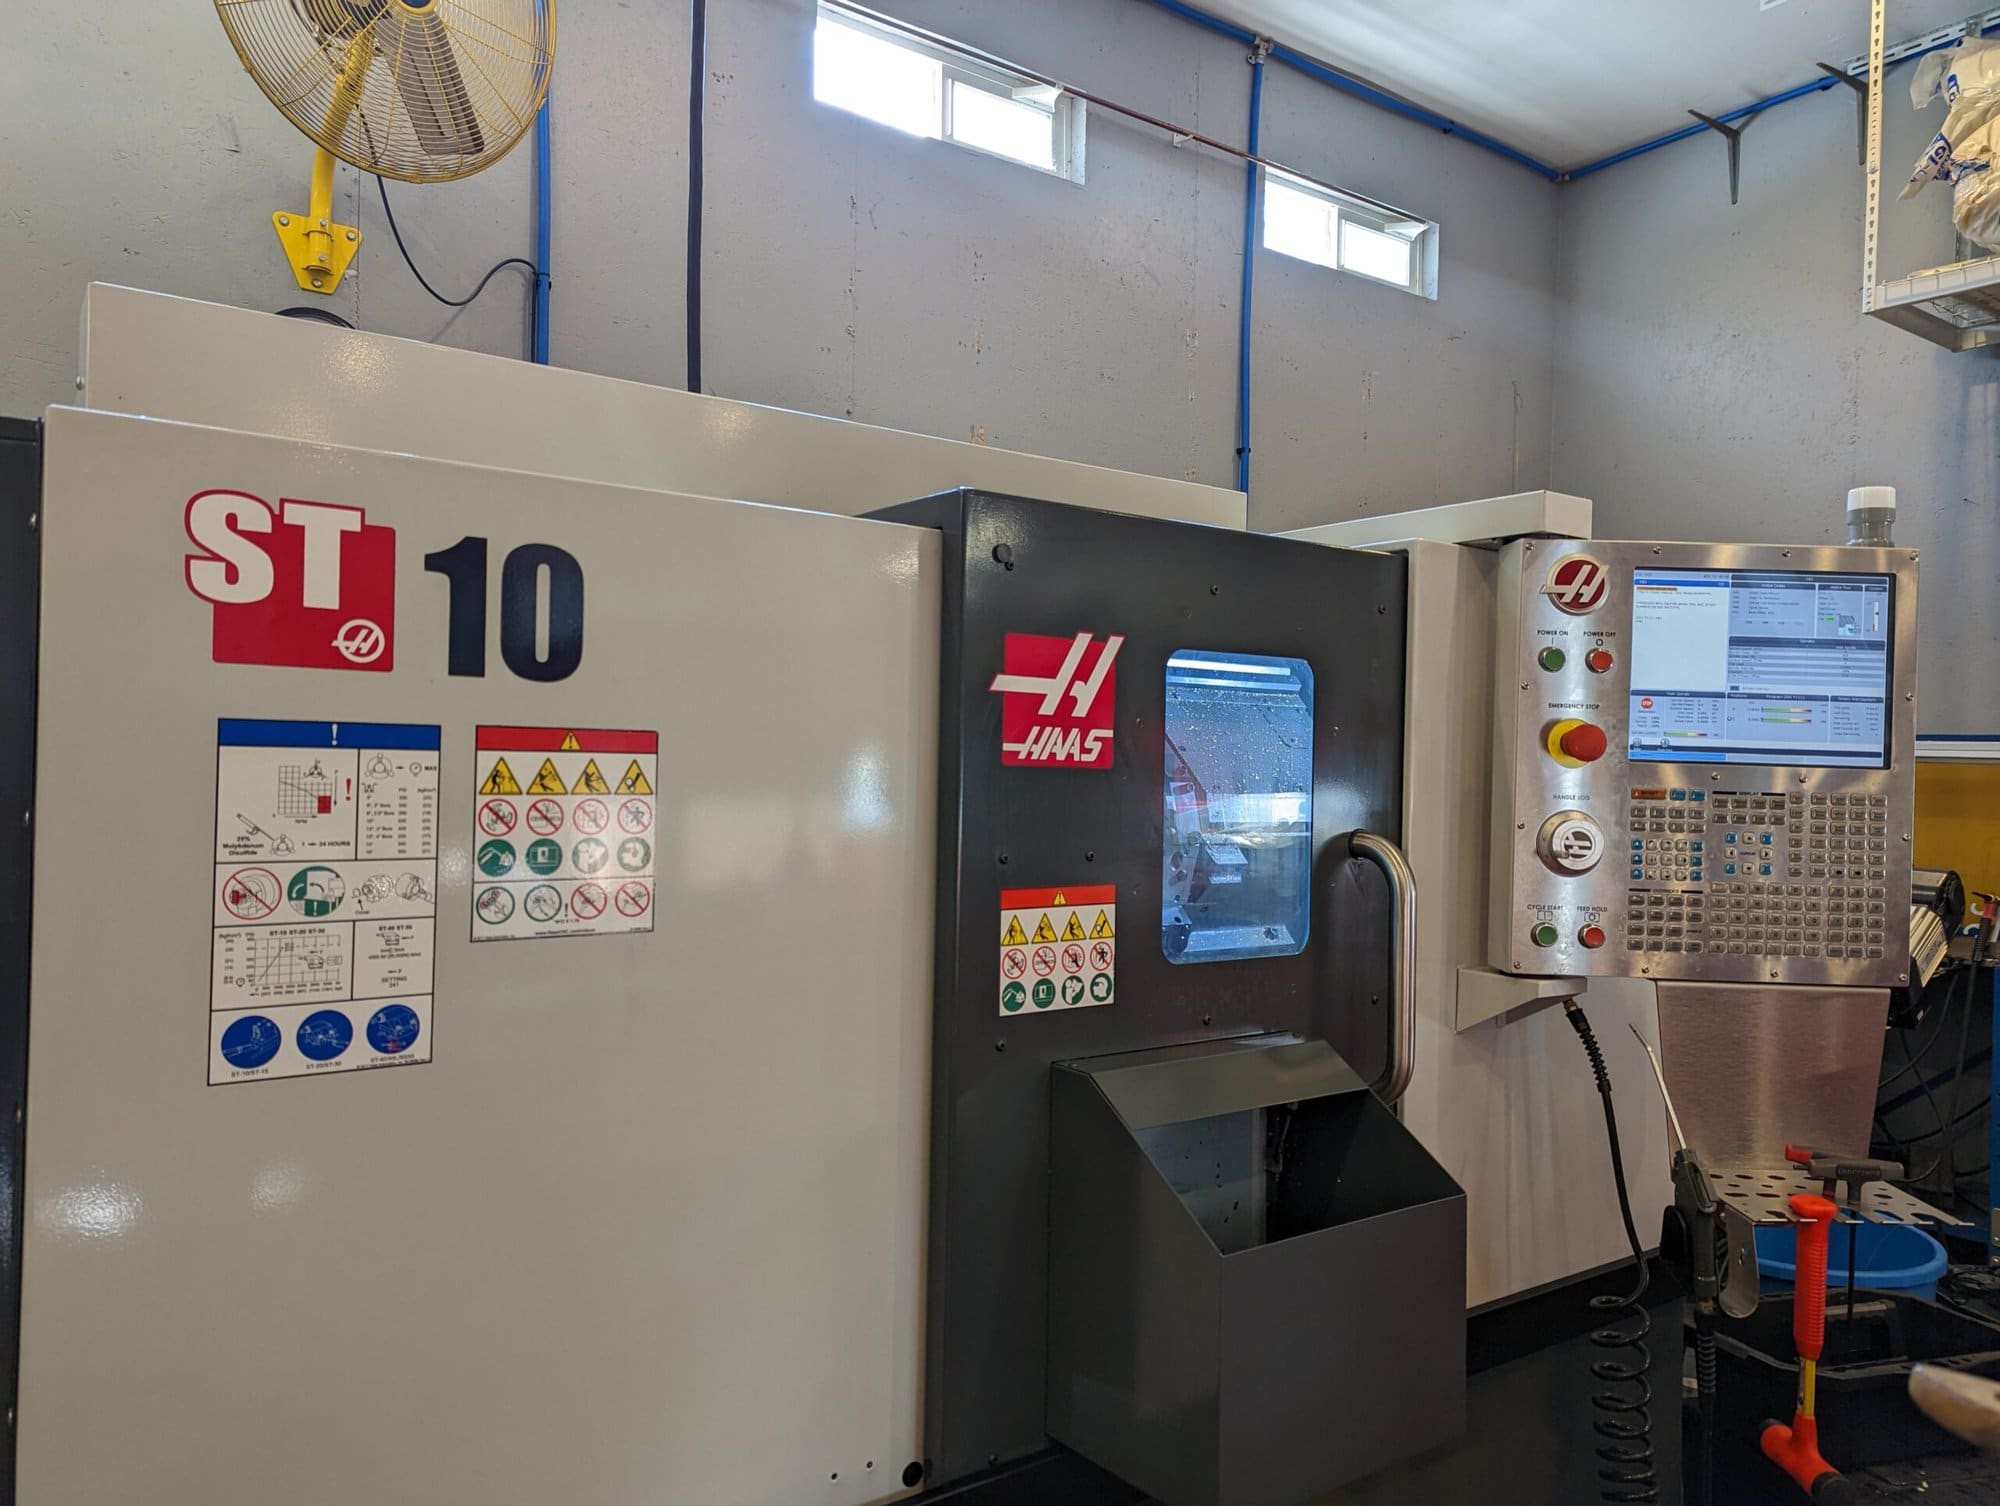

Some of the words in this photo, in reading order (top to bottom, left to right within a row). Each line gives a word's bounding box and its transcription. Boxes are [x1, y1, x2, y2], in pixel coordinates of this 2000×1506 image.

[187, 491, 363, 611] ST
[424, 536, 584, 682] 10
[1002, 725, 1114, 762] HAAS
